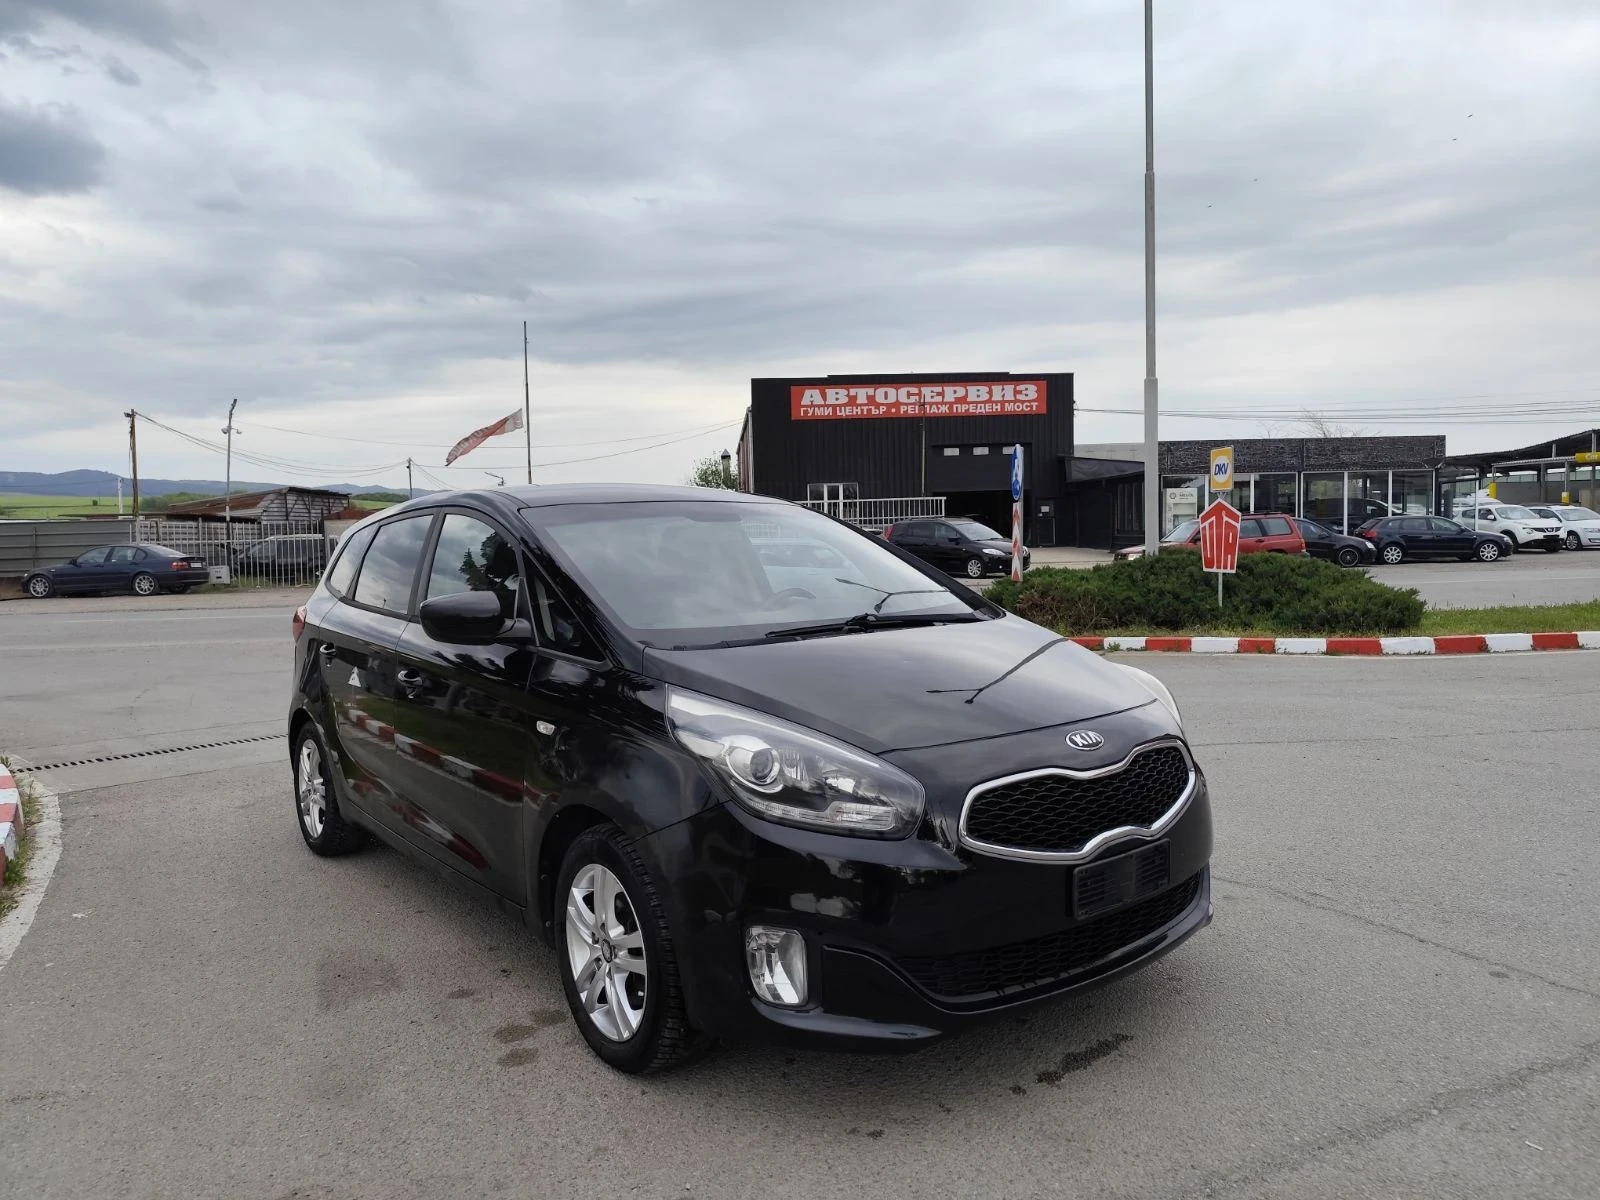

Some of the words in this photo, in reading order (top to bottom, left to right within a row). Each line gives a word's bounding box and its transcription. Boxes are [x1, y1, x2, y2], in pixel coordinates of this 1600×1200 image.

[801, 384, 1038, 405] АВТОСЕРВИЗ
[800, 406, 833, 416] ГУМИ
[836, 405, 887, 416] ЦЕНТЪР
[953, 402, 1001, 414] ПРЕДЕН
[1004, 402, 1039, 412] МОСТ
[1214, 463, 1229, 476] DKV
[1201, 501, 1240, 571] UTA
[1071, 732, 1101, 747] KIA
